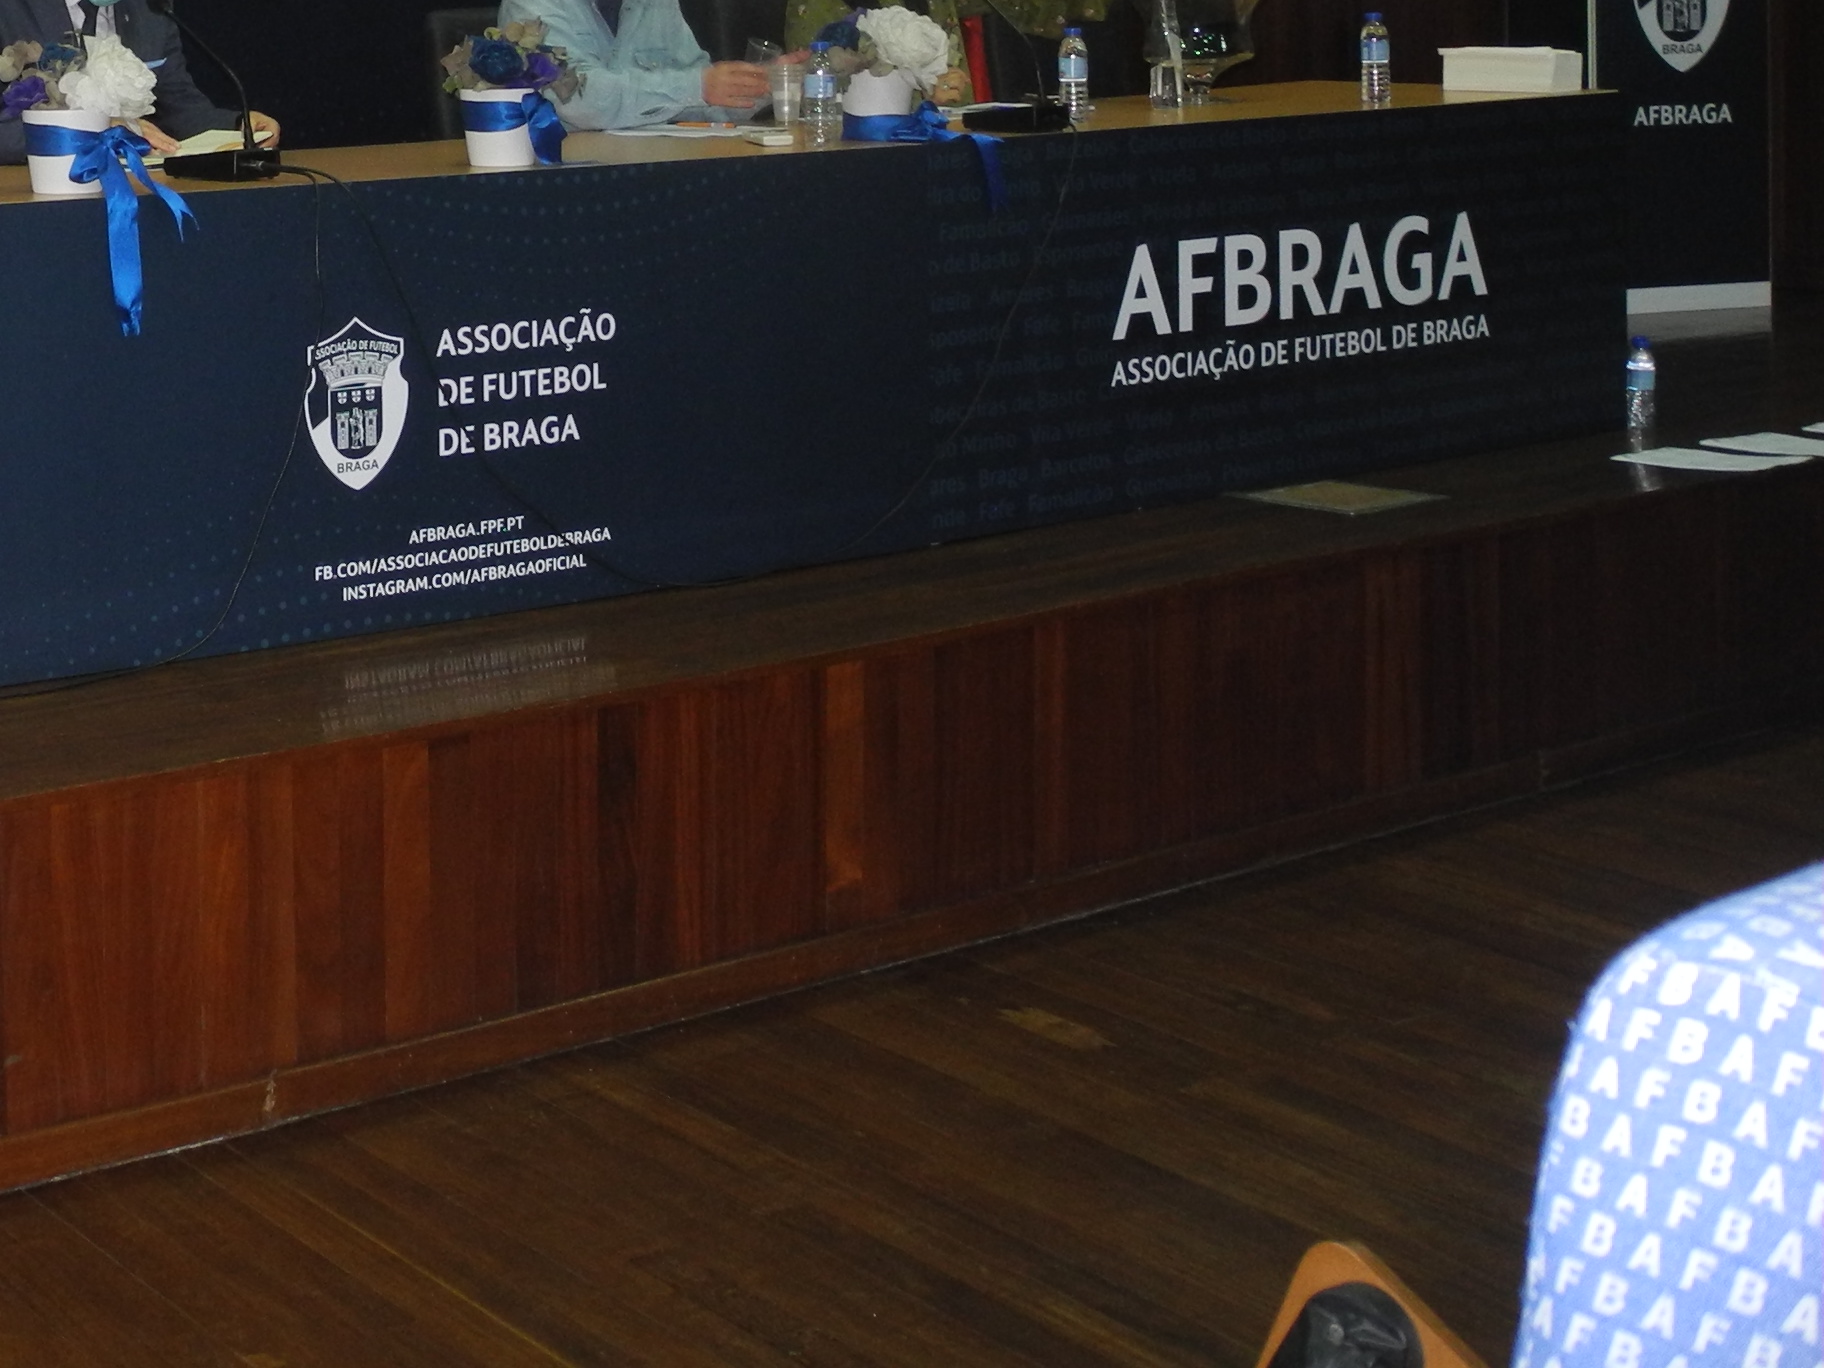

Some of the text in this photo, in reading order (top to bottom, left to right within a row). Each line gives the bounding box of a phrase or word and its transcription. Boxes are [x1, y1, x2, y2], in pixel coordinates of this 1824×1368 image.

[1662, 43, 1703, 55] BRAGA
[1633, 102, 1733, 127] AFBRAGA
[1112, 210, 1489, 341] AFBRAGA
[436, 307, 616, 358] ASSOCIAÇÃO
[1111, 314, 1490, 387] ASSOCIAÇÃO DE FUTEBOL DE BRAGA
[438, 362, 607, 407] DE FUTEBOL
[438, 414, 580, 457] DE BRAGA
[336, 459, 380, 475] BRAGA
[409, 515, 525, 544] AFBRAGA.FPF.PT
[342, 553, 587, 602] INSTAGRAM.COM/AFBRAGAOFICIAL
